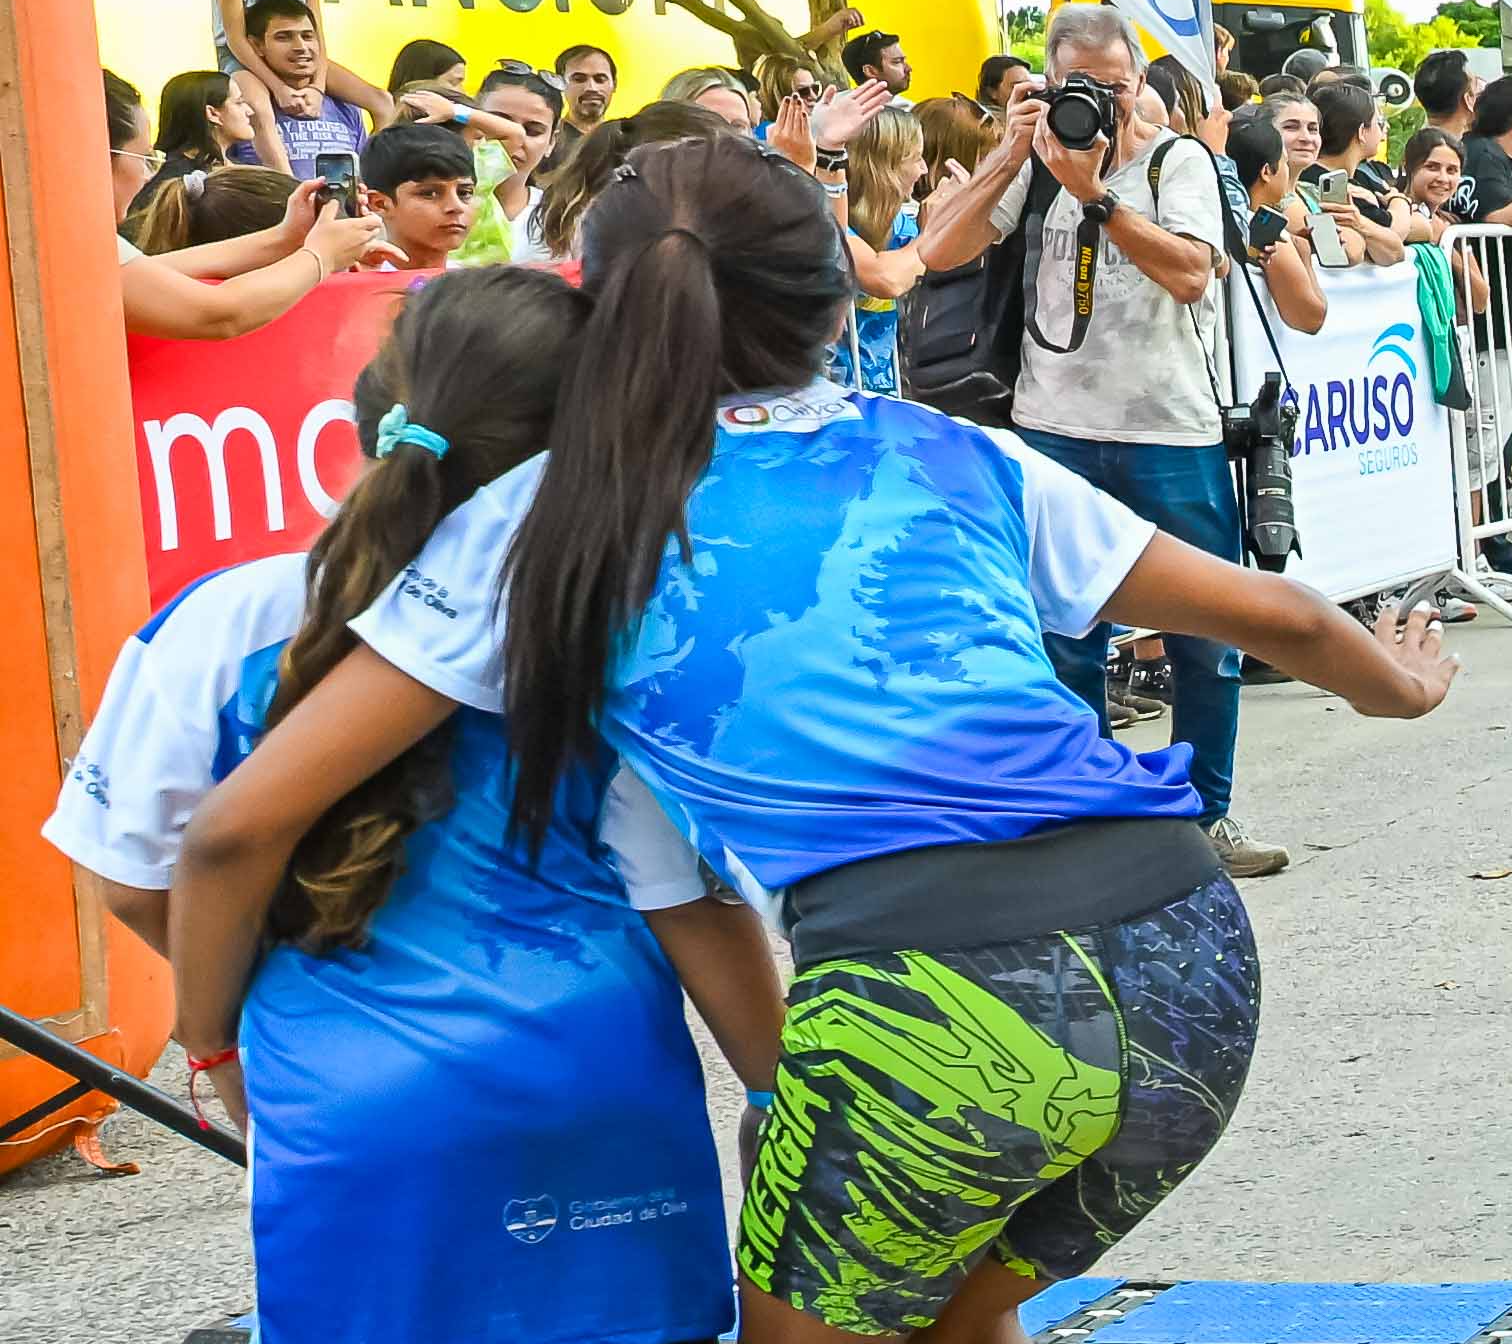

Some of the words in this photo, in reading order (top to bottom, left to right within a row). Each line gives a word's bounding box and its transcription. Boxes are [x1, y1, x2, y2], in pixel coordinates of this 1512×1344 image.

[1079, 246, 1092, 280] Nikon
[1359, 442, 1418, 476] SEGUROS
[569, 1209, 633, 1231] Ciudad
[639, 1208, 658, 1221] de
